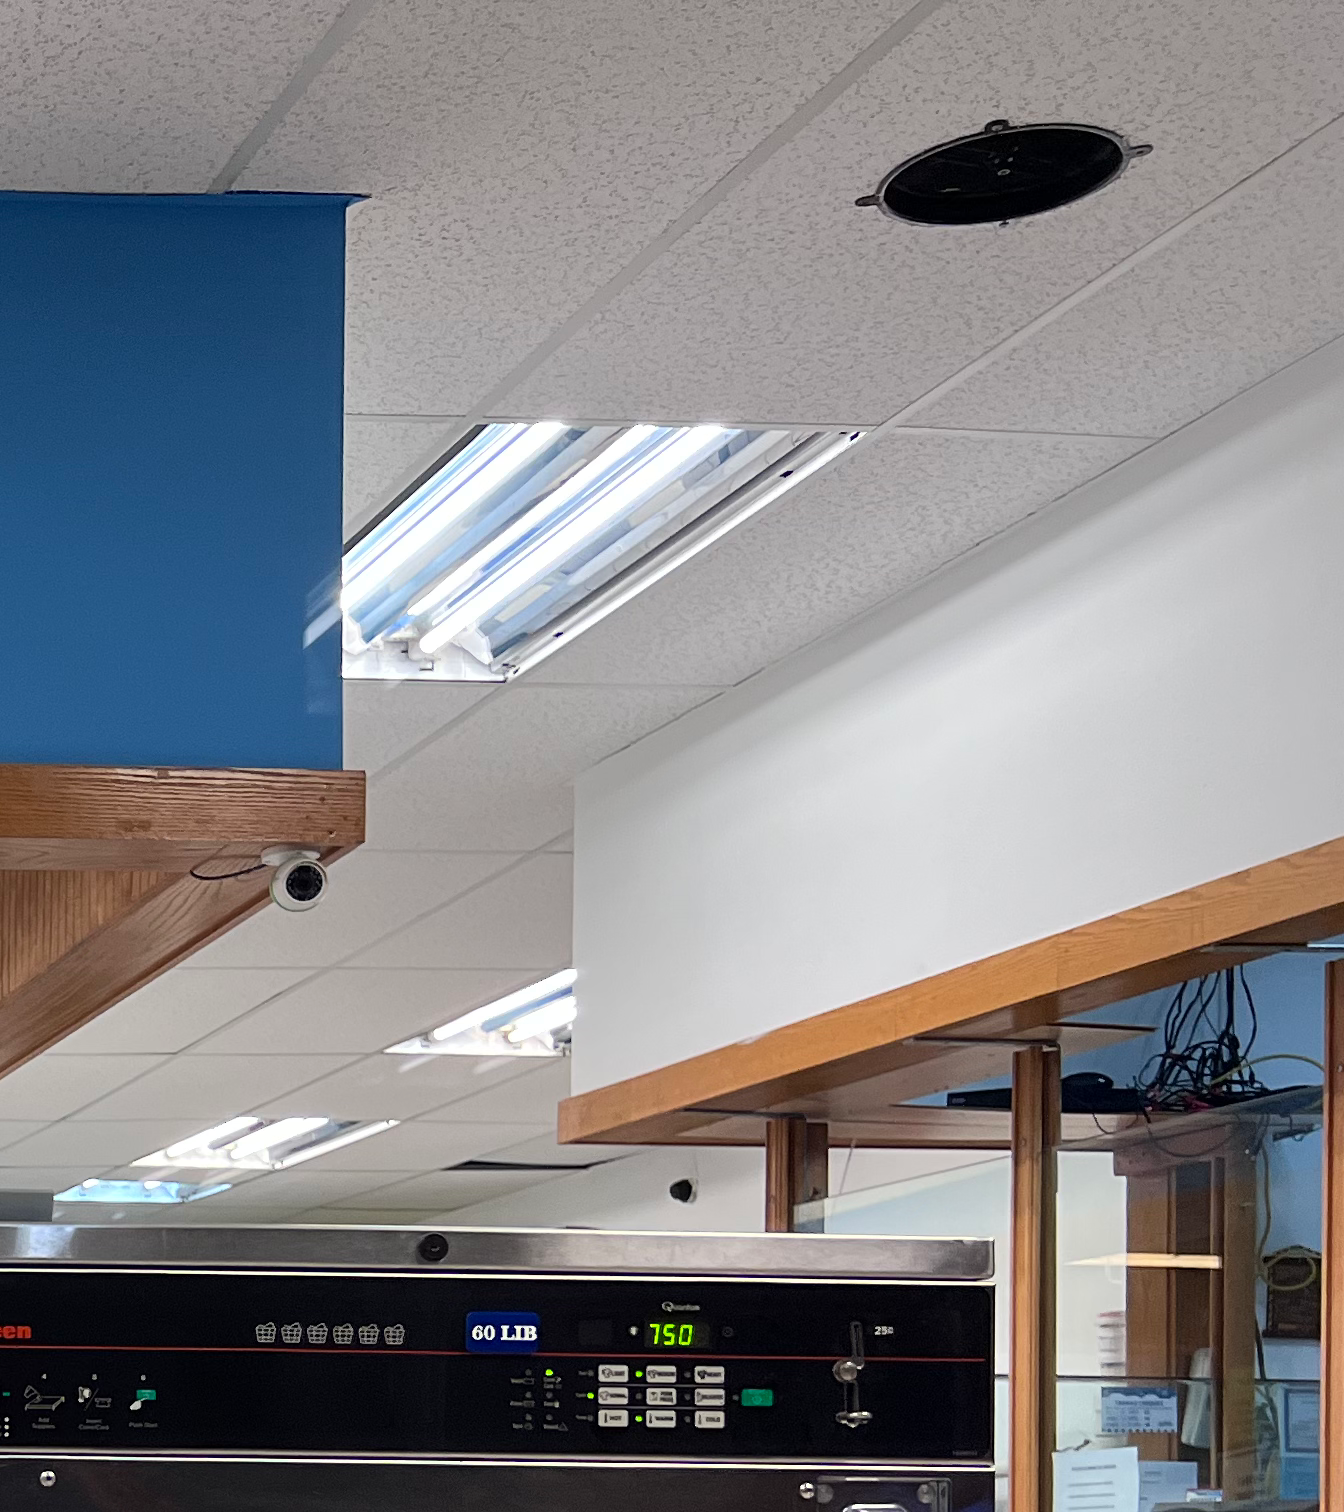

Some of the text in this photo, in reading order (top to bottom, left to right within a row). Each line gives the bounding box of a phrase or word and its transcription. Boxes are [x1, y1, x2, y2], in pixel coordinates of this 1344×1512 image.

[471, 1324, 538, 1342] 60 LIB
[649, 1323, 694, 1346] 750
